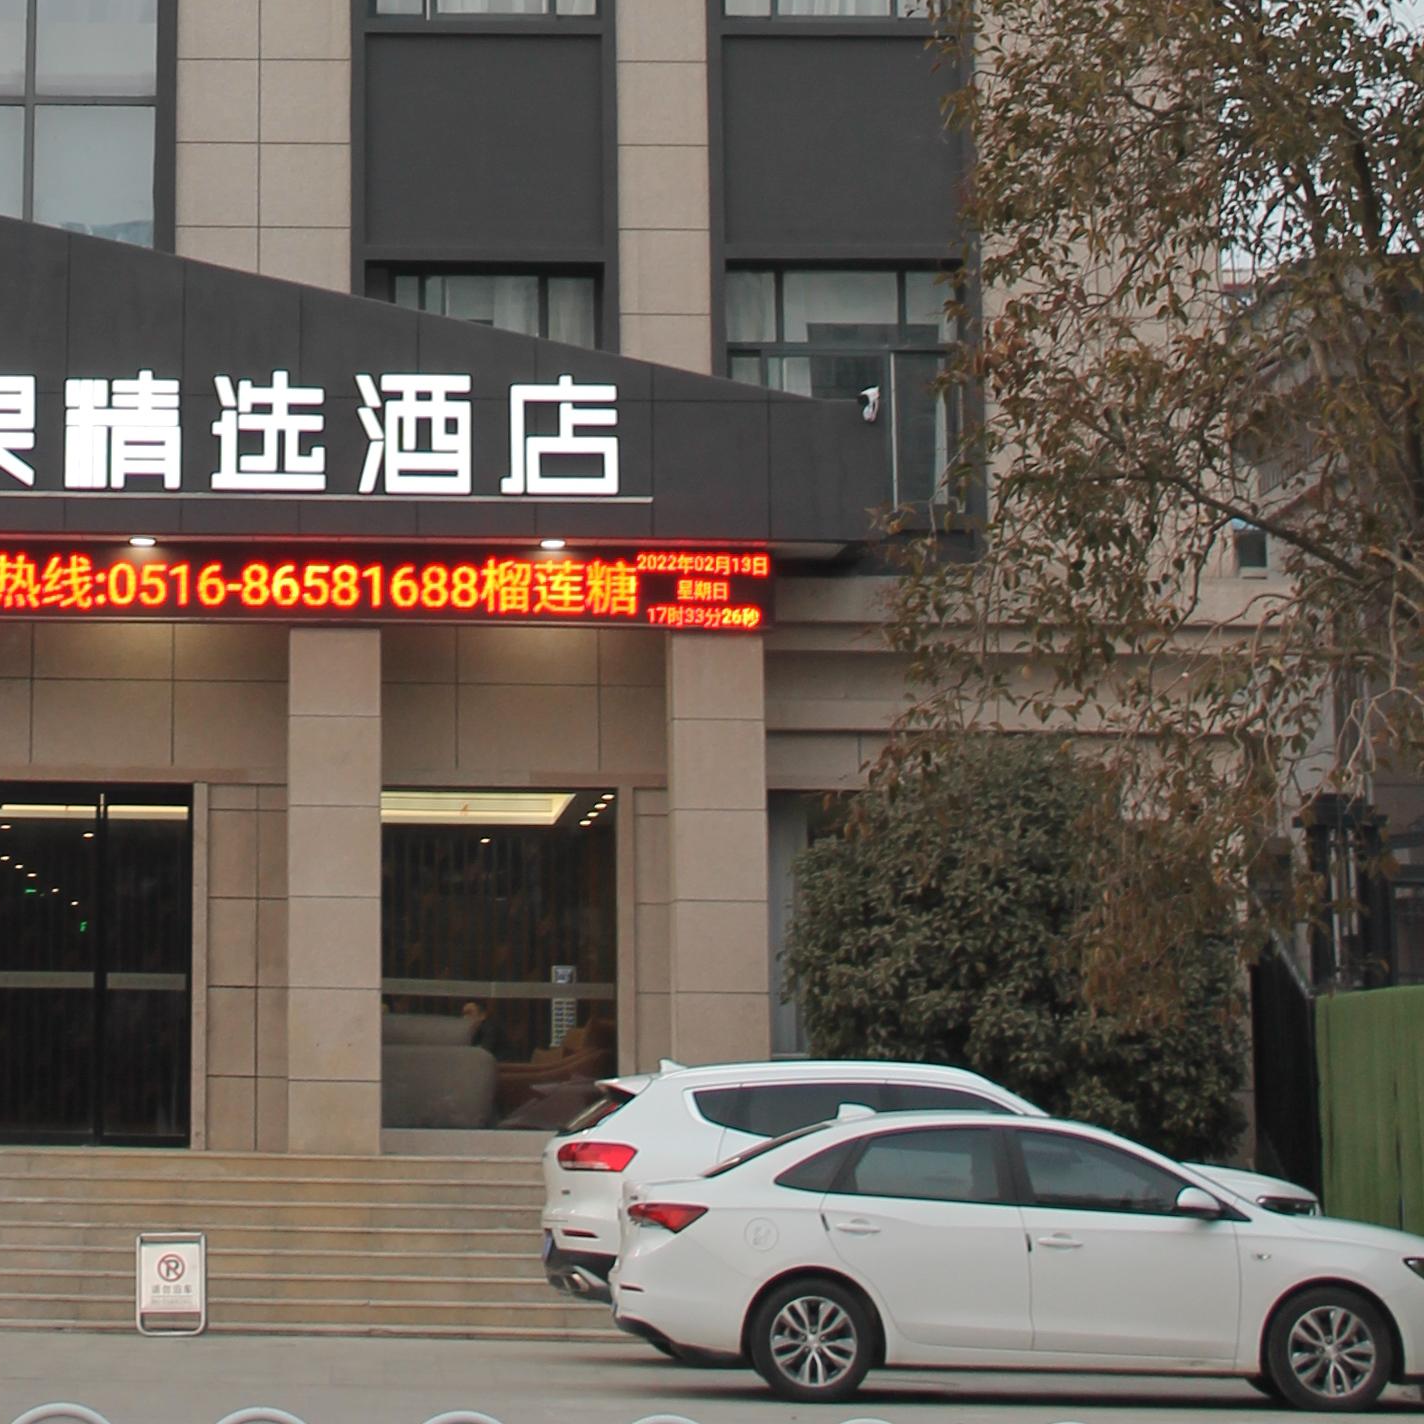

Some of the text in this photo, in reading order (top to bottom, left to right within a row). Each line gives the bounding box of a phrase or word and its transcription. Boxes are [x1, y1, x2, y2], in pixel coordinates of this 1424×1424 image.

[636, 553, 769, 576] 2022年02月13日
[677, 579, 728, 601] 星期日
